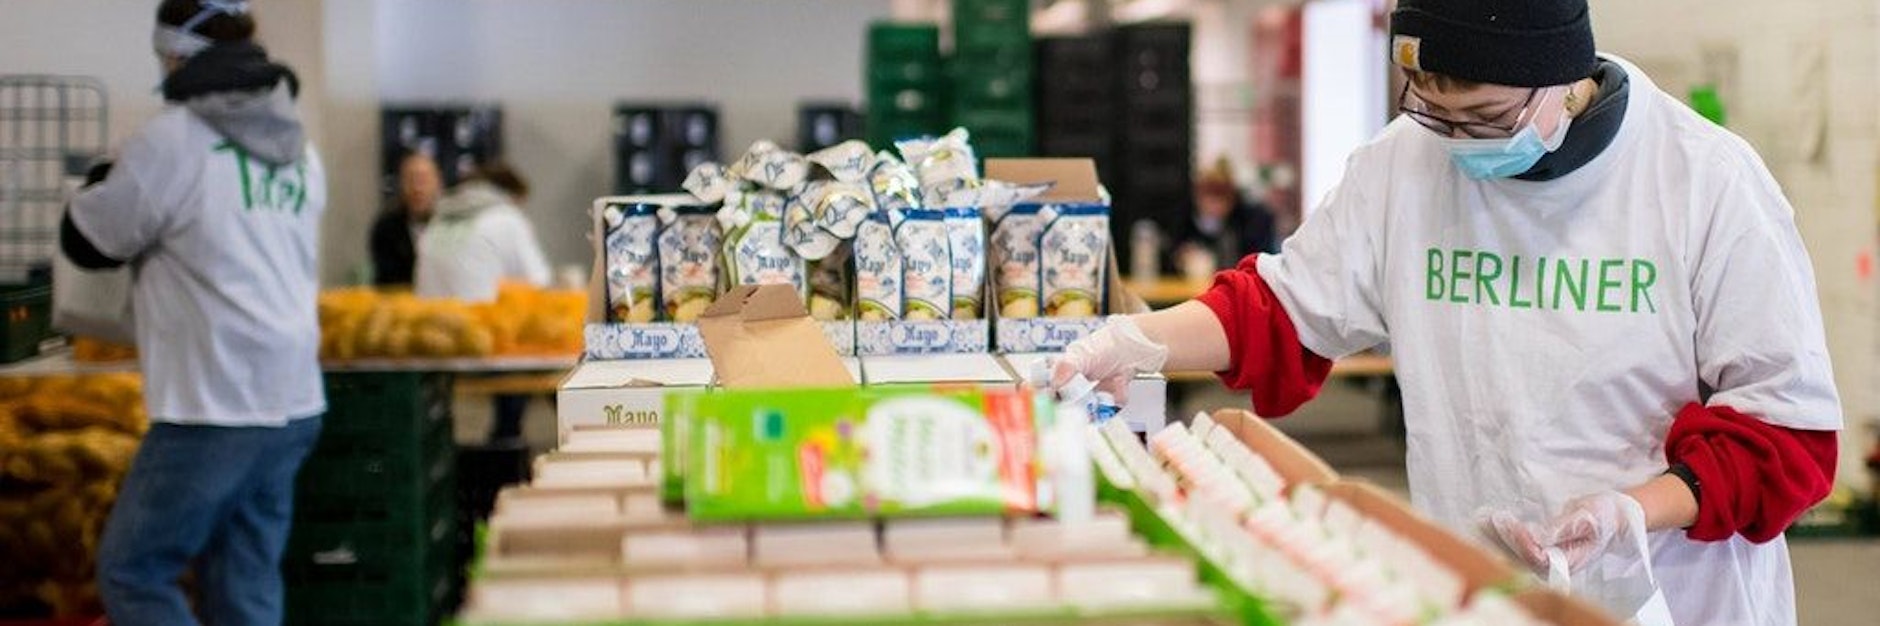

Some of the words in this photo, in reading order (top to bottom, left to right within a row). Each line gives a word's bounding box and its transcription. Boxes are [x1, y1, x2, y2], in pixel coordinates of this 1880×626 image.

[757, 255, 790, 271] Mayo
[1426, 248, 1657, 313] BERLINER
[632, 328, 668, 349] Mayo
[903, 325, 939, 346] Mayo
[1043, 324, 1078, 345] Mayo
